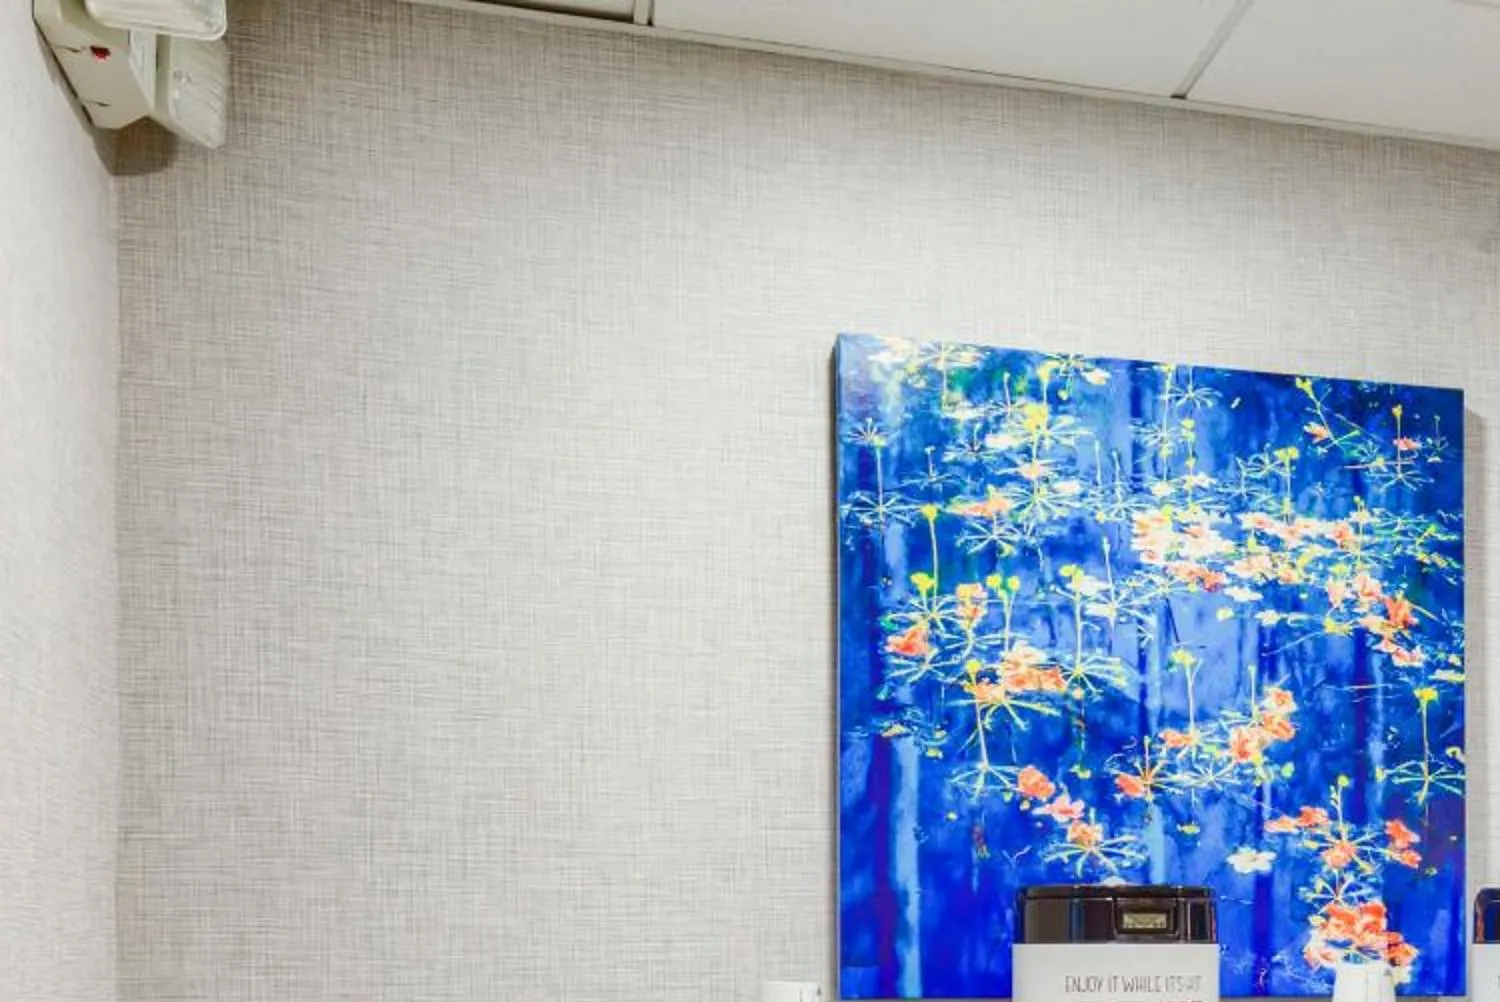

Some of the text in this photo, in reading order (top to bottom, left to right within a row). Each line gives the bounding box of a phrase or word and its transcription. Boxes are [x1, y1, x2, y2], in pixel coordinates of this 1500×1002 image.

[1065, 975, 1103, 993] ENJOY
[1107, 975, 1118, 993] IT
[1121, 975, 1162, 993] WHILE
